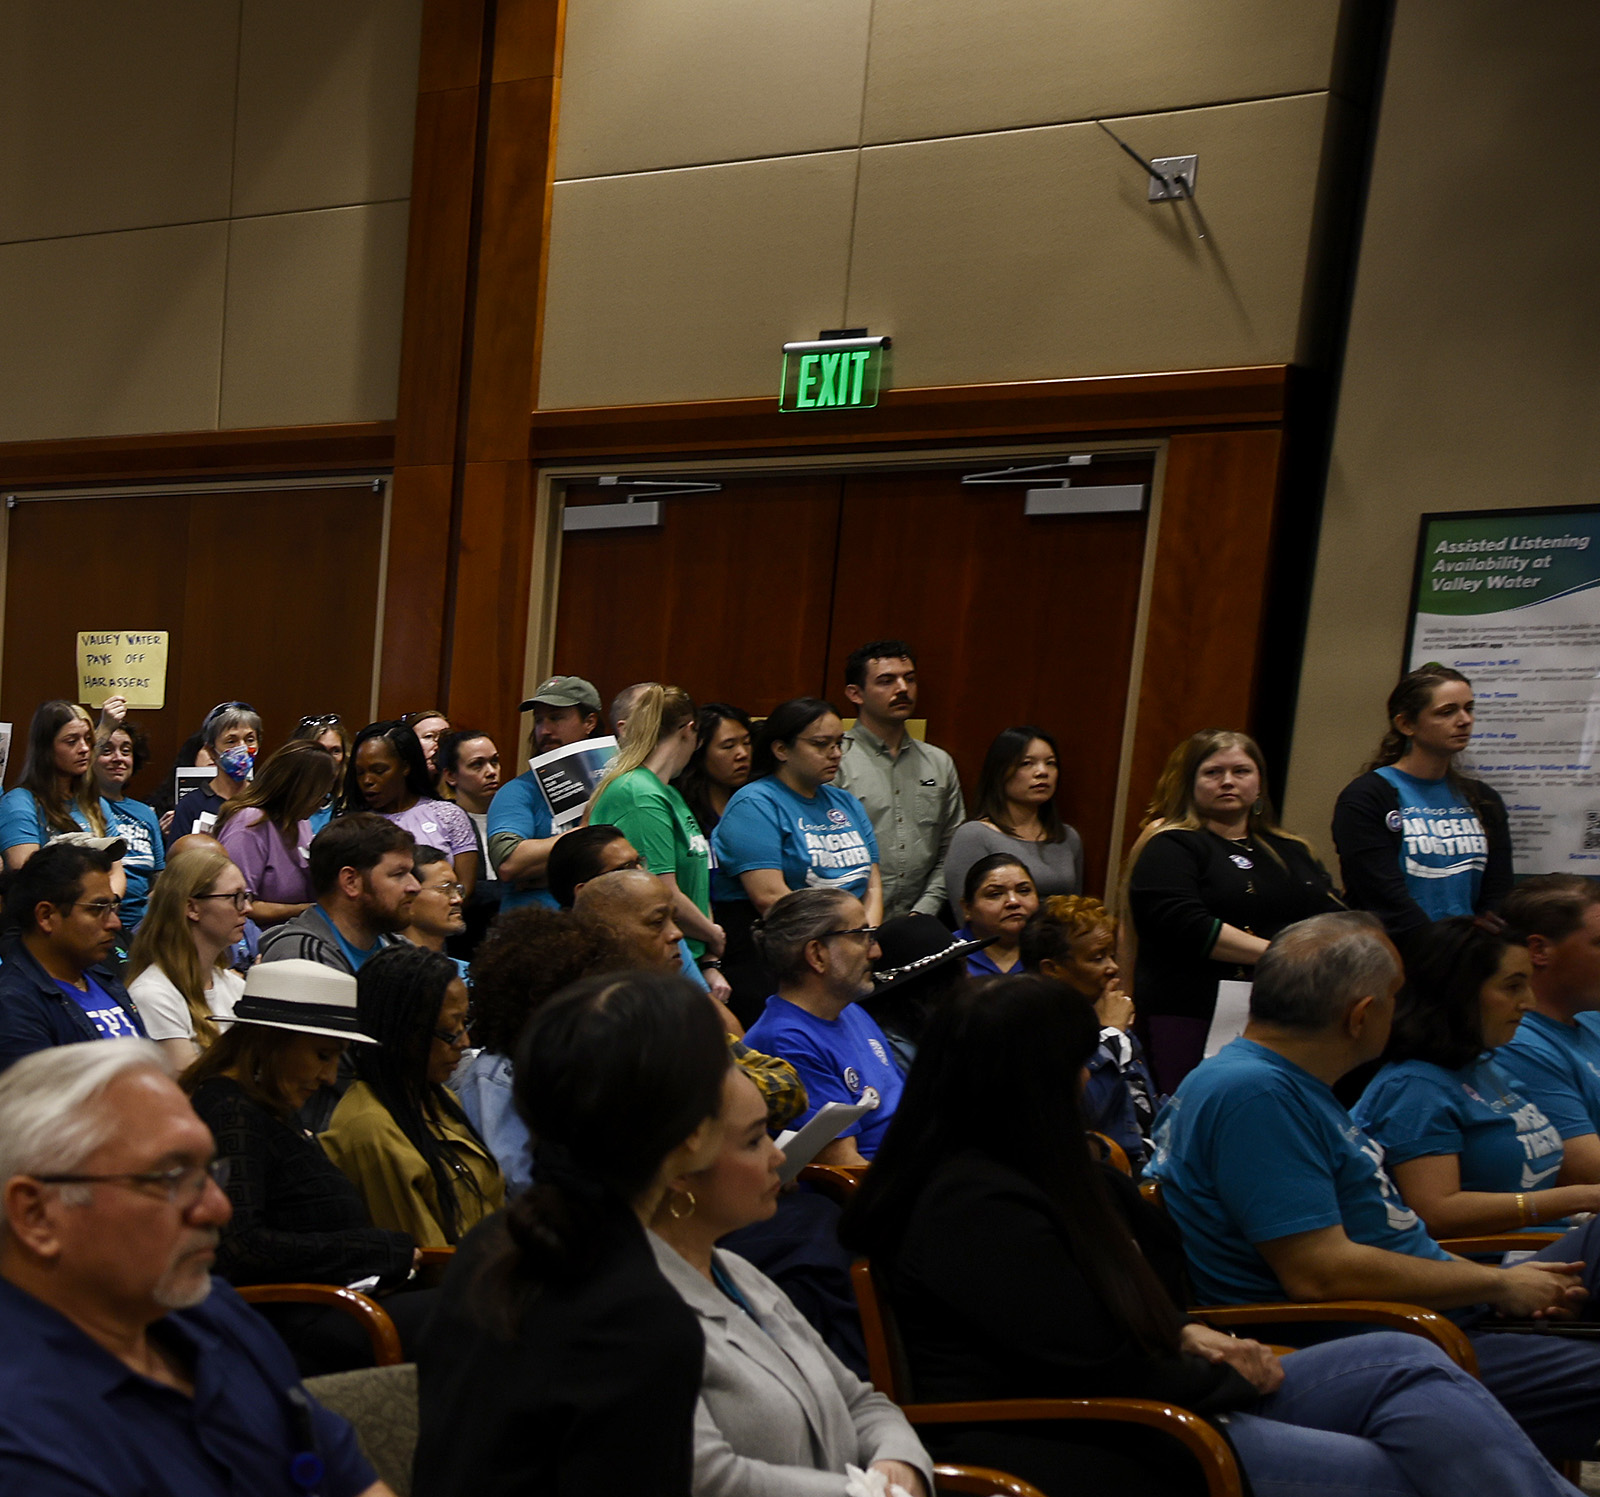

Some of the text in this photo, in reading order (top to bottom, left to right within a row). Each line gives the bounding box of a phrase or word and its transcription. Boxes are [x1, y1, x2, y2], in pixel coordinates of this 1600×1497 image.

[796, 351, 871, 408] EXIT
[1433, 534, 1591, 554] Assisted Listening
[1431, 555, 1552, 573] Availability at
[1431, 575, 1542, 593] Valley Water
[81, 634, 162, 647] VALLEY WATER
[86, 653, 146, 667] PAYS OFF
[83, 675, 151, 689] HARASSERS
[1403, 817, 1428, 836] AN
